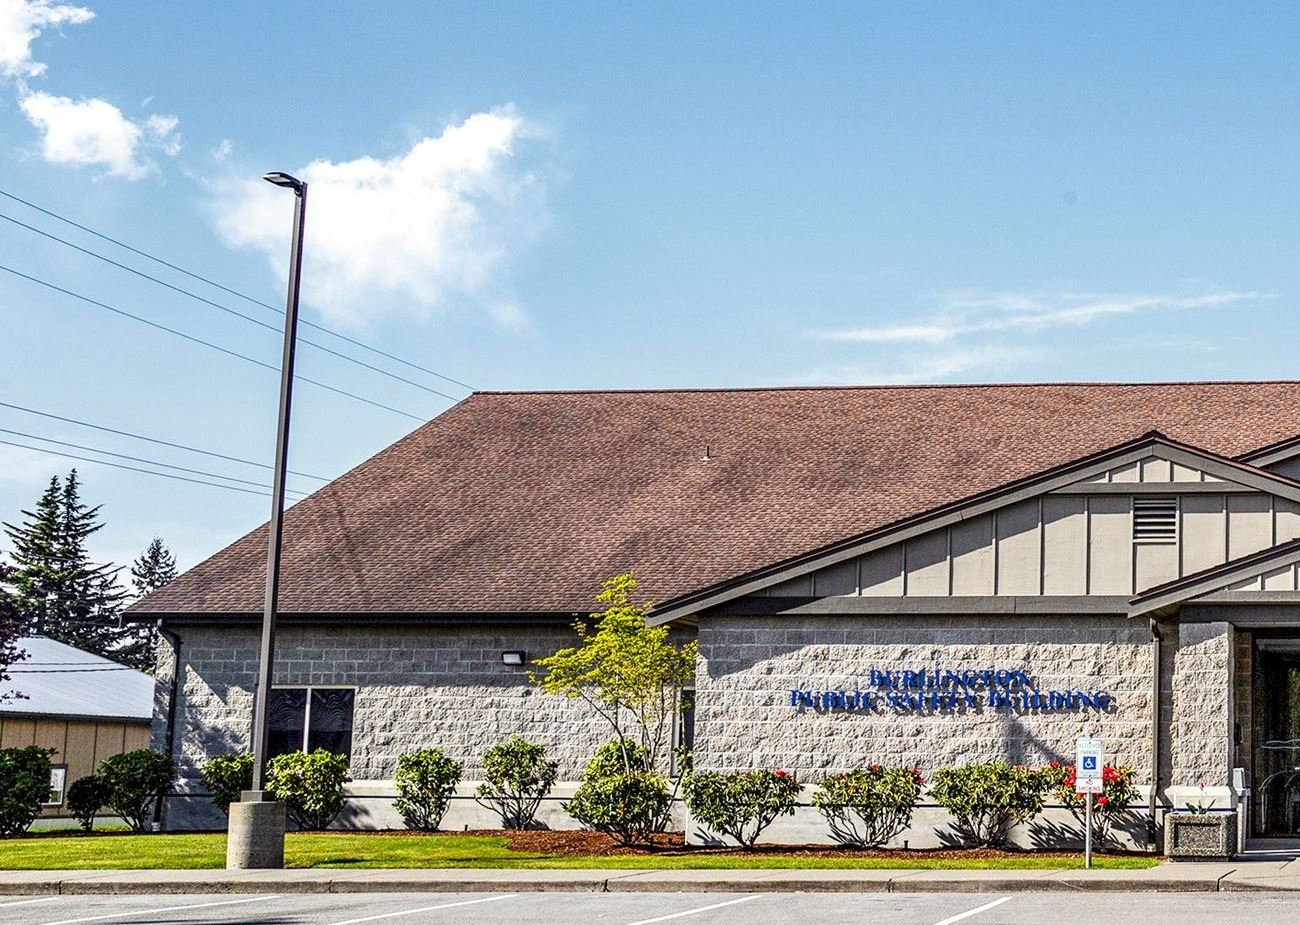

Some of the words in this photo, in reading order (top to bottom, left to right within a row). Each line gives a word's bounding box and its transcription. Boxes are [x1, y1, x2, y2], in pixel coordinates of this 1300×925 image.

[869, 668, 1030, 688] BURLINGTON
[791, 690, 878, 709] PUBLIC
[885, 690, 975, 710] SAFETY
[988, 689, 1112, 709] BUILDING
